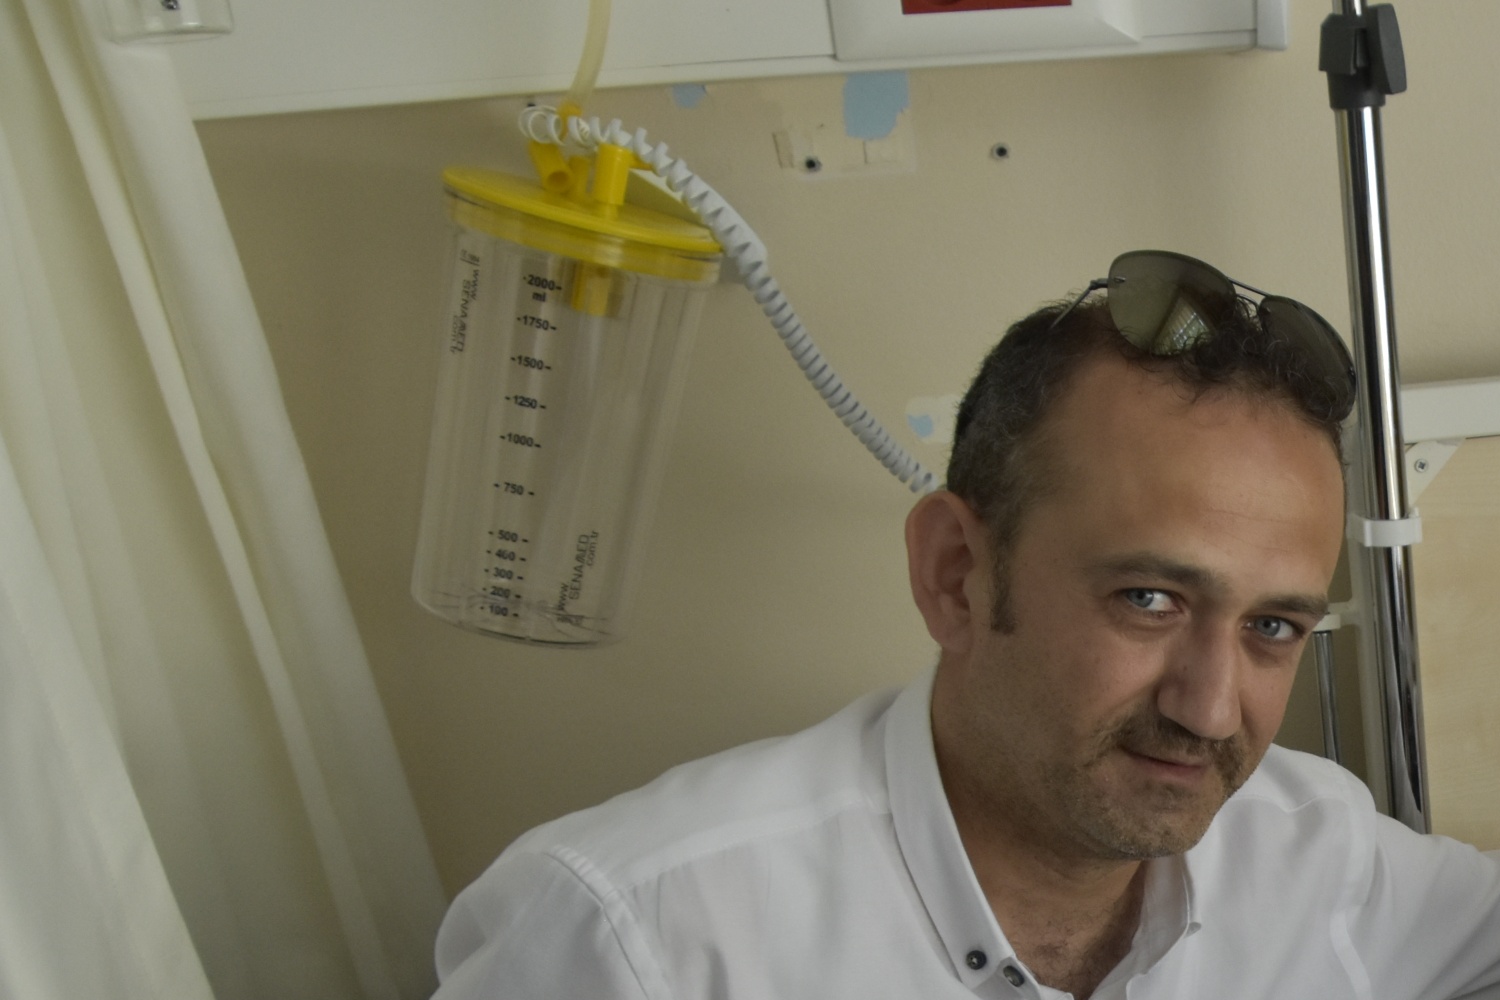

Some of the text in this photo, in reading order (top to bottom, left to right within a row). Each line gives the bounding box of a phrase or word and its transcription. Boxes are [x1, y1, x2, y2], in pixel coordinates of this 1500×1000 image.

[527, 274, 555, 291] 2000
[532, 292, 546, 302] ml
[523, 315, 549, 330] 1750
[516, 355, 544, 370] 1500
[513, 395, 538, 409] 1250
[506, 433, 534, 447] 1000
[504, 482, 524, 495] 750
[498, 529, 519, 542] 500
[493, 567, 513, 580] 300
[567, 534, 590, 600] SENAMED
[490, 585, 511, 599] 200
[488, 604, 509, 617] 100
